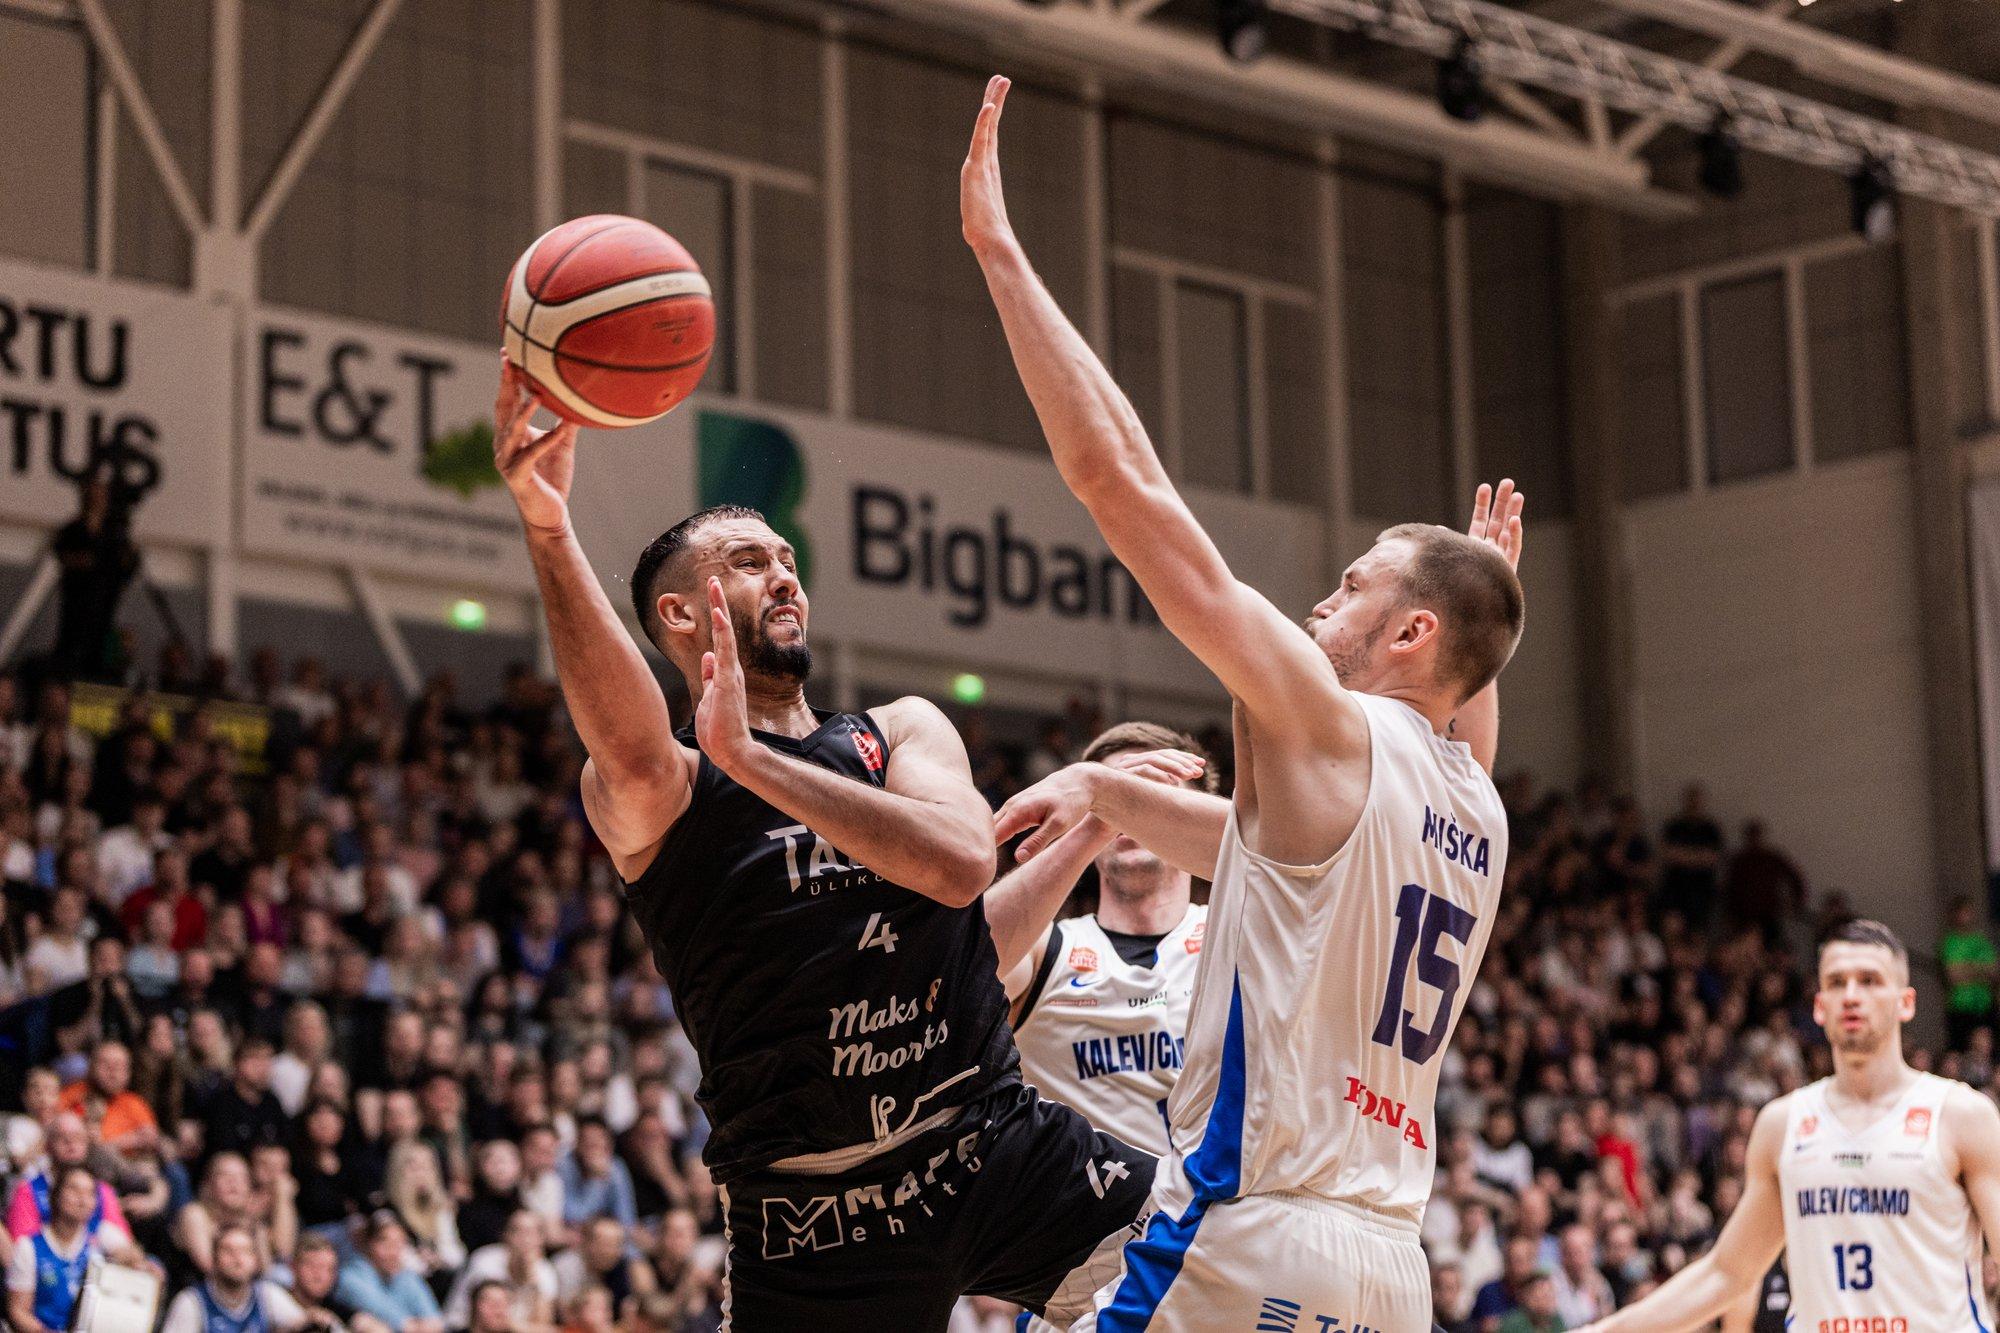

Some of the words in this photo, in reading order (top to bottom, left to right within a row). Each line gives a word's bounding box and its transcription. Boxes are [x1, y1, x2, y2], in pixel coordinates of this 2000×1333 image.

[258, 324, 455, 484] E&T
[851, 482, 1160, 630] Bigban
[764, 824, 867, 893] TA
[1420, 803, 1490, 878] MIŠKA
[857, 911, 900, 954] 4
[1371, 882, 1479, 1066] 15
[827, 994, 920, 1040] Maks
[851, 1155, 983, 1243] ehitu
[1832, 1243, 1874, 1291] 13
